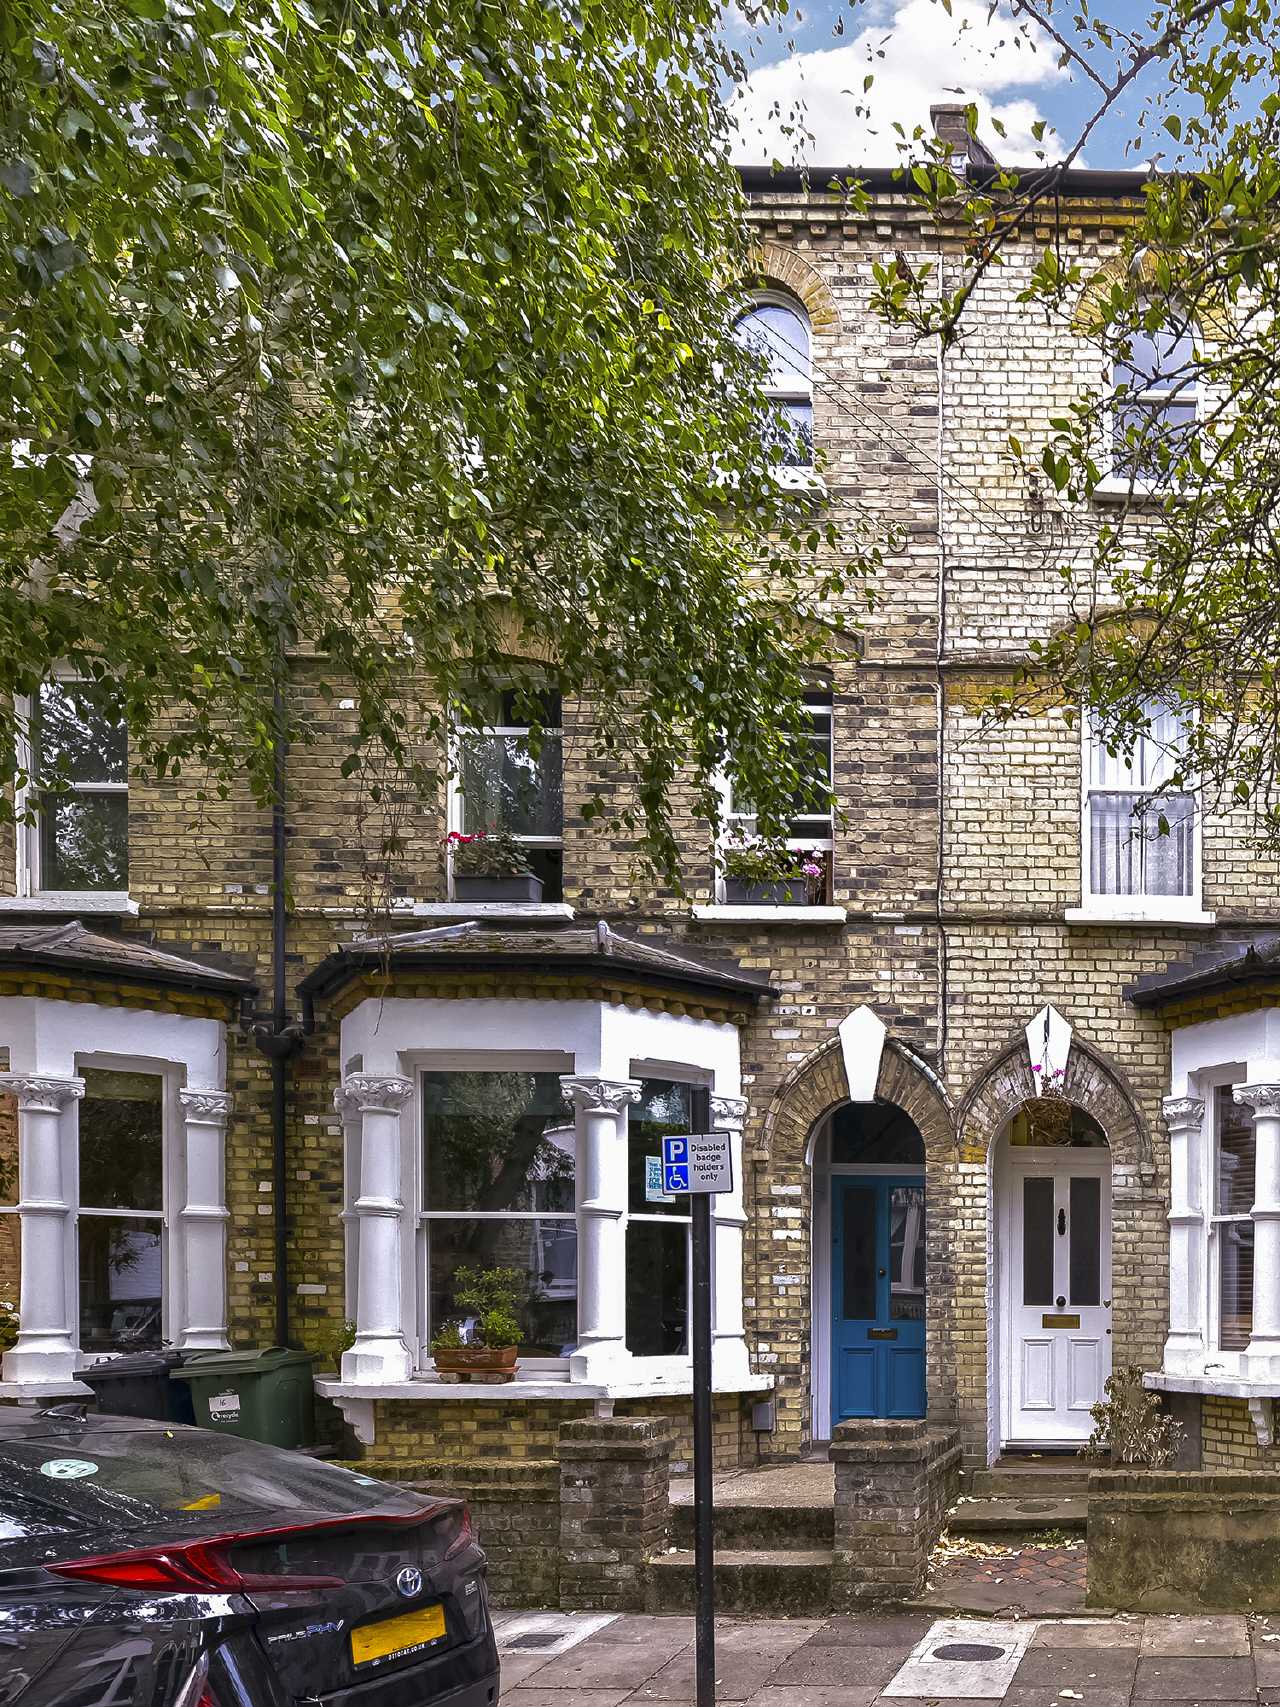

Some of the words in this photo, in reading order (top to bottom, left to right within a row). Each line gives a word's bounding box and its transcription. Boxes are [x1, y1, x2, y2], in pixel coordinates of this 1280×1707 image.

[670, 1140, 684, 1161] P
[691, 1143, 726, 1152] Disabled
[696, 1153, 721, 1162] badge
[693, 1163, 724, 1171] holders
[700, 1173, 718, 1181] only
